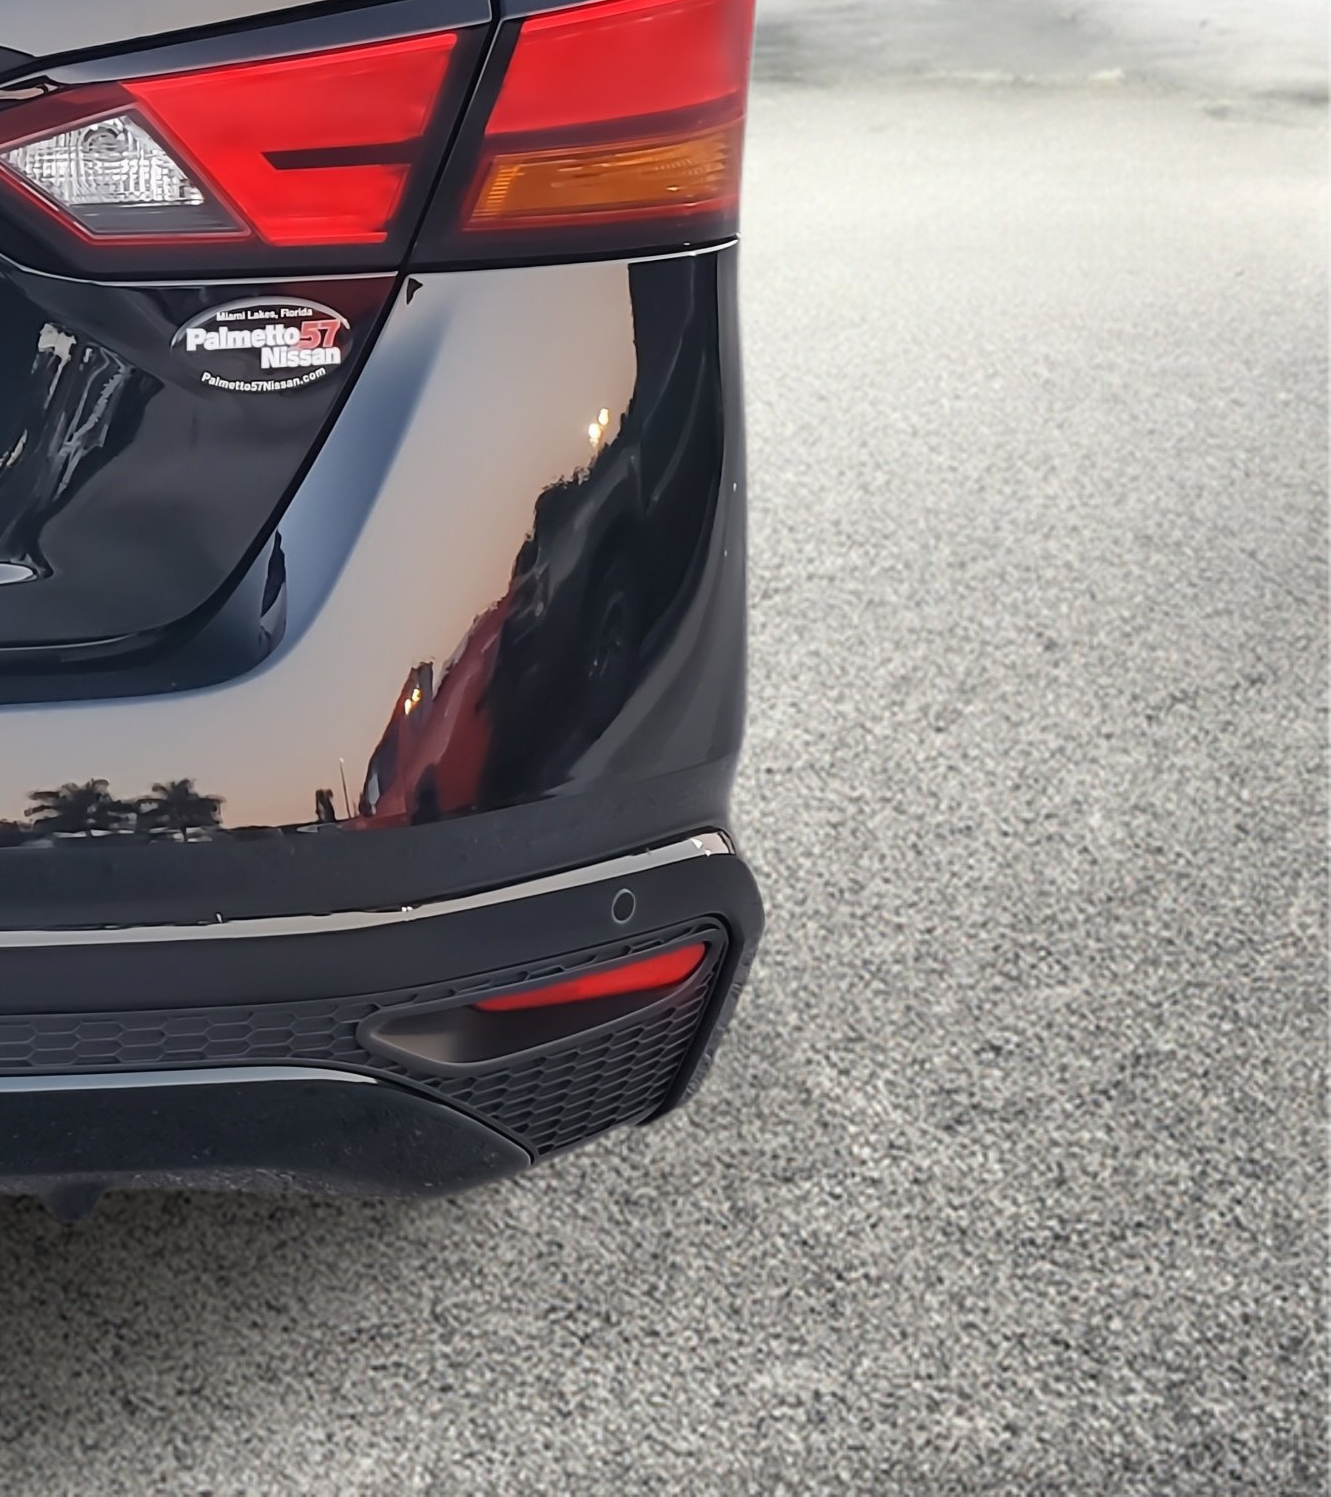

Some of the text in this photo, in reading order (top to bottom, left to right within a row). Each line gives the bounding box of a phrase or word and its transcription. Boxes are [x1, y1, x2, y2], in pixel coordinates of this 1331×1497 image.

[216, 307, 313, 320] Miami Lakes, Florida
[186, 319, 341, 351] Palmetto57
[260, 346, 342, 369] Nissan
[201, 366, 327, 392] Palmetto57Nissan.com
